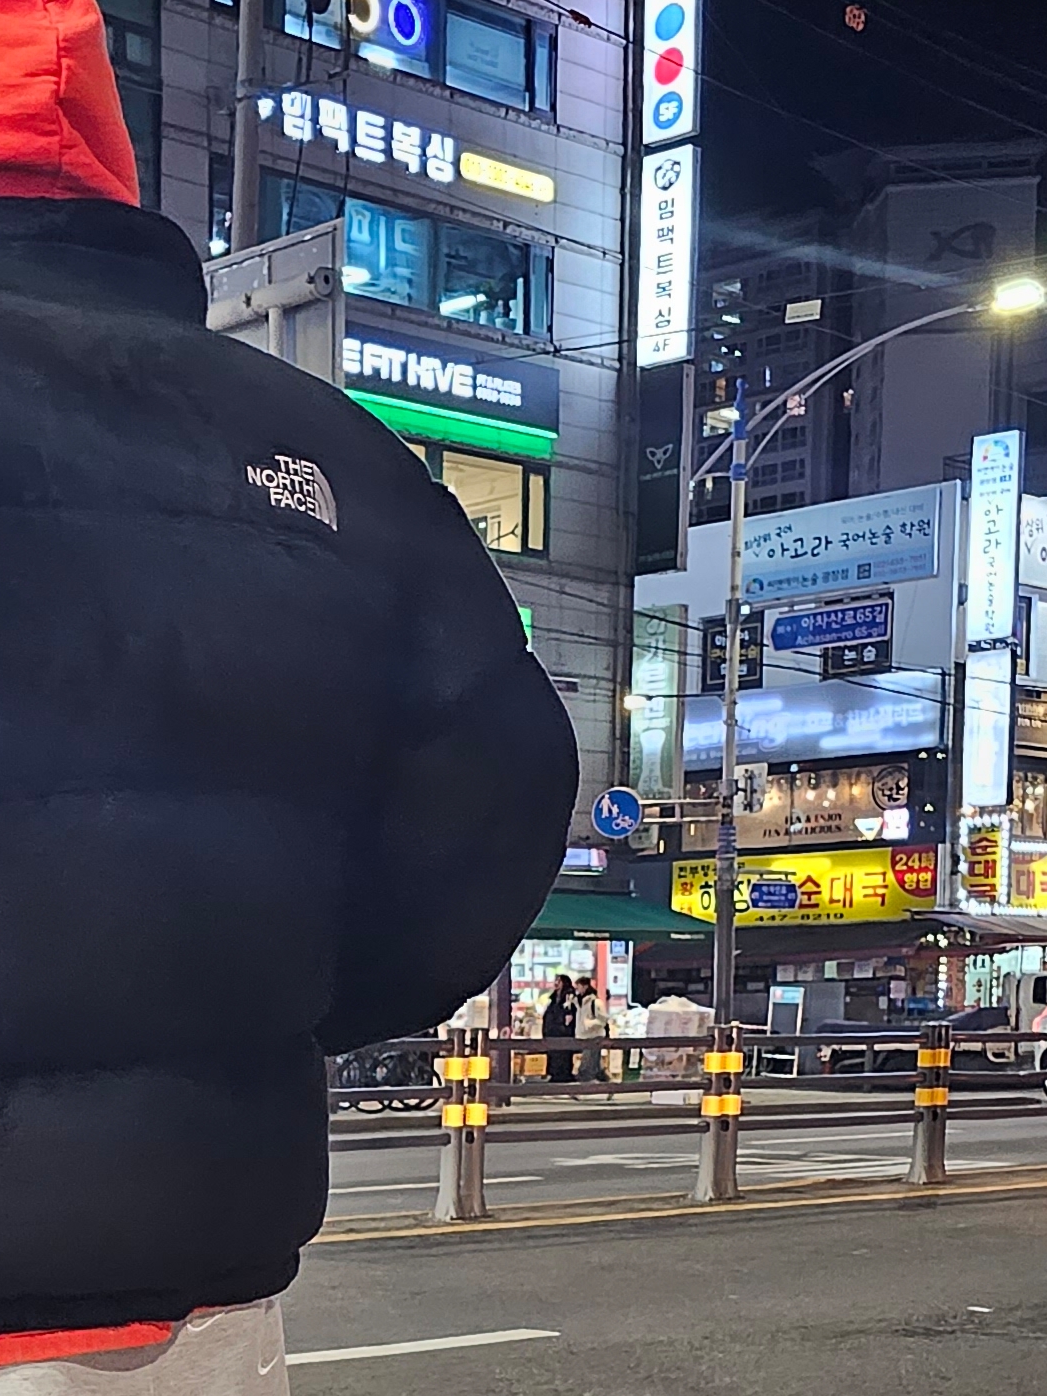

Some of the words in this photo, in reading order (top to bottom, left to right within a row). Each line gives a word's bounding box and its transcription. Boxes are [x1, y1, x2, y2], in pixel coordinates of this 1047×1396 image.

[658, 101, 679, 122] 5F
[281, 91, 455, 183] 임팩트복싱
[655, 198, 675, 328] 임팩트복싱
[362, 342, 407, 382] FIT
[407, 353, 474, 398] HIVE
[246, 465, 314, 497] NORTH
[274, 455, 314, 480] THE
[269, 487, 318, 517] FACE
[767, 535, 833, 560] 아고라
[838, 524, 895, 550] 국어논술
[899, 518, 931, 539] 학원
[983, 504, 1003, 555] 아고라
[801, 605, 886, 630] 아차산로65길
[904, 871, 932, 890] 영업
[969, 836, 999, 902] 순대국
[797, 871, 889, 910] 순대국
